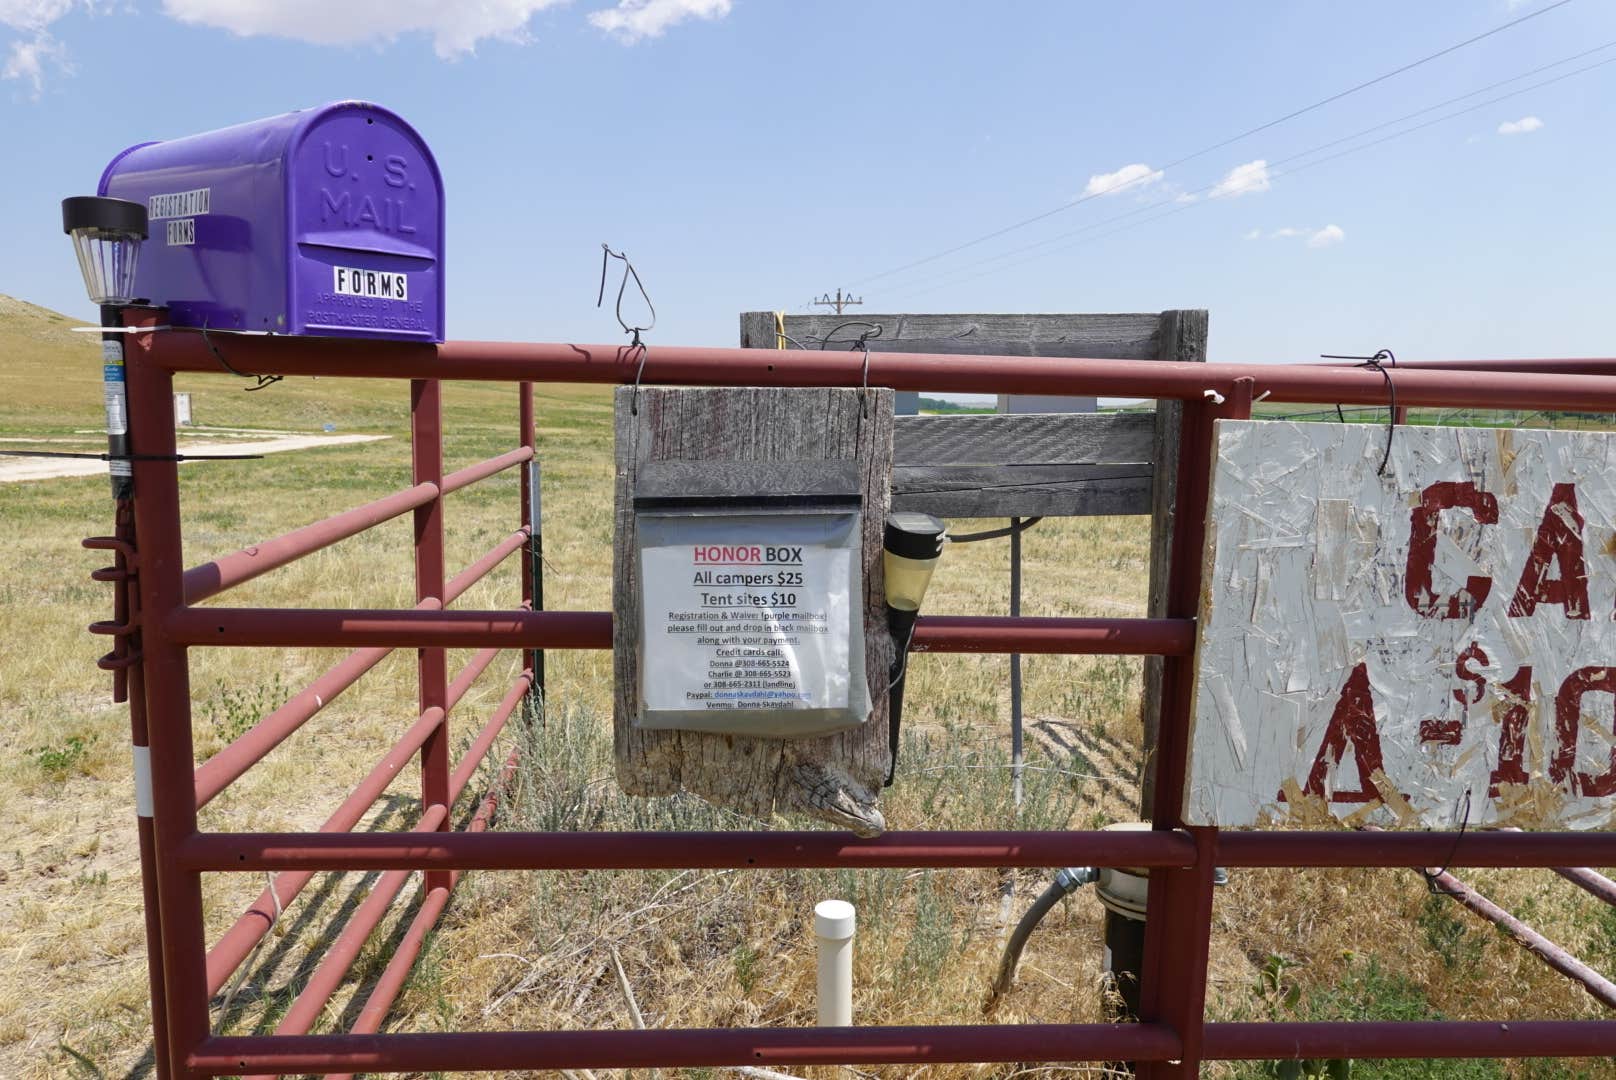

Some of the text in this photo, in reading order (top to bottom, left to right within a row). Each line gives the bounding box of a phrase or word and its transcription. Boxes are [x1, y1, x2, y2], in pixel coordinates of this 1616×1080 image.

[150, 189, 209, 218] REGISTRATION
[321, 187, 416, 233] MAIL
[168, 220, 194, 244] FORMS
[338, 269, 404, 298] FORMS
[694, 546, 802, 562] HONOR BOX
[694, 571, 803, 587] All campers $25
[701, 592, 796, 607] Tent sites $10
[668, 611, 719, 621] Registration
[721, 611, 728, 620] &
[730, 611, 758, 620] Waiver
[761, 611, 790, 621] (purple
[667, 624, 695, 633] please
[697, 623, 708, 632] fill
[726, 624, 741, 632] and
[743, 624, 762, 633] drop
[764, 624, 772, 632] in
[774, 624, 794, 632] black
[697, 636, 720, 645] along
[722, 636, 740, 644] with
[743, 637, 761, 645] your
[716, 648, 741, 656] Credit
[766, 649, 783, 657] call:
[708, 670, 733, 678] Charlie
[762, 680, 795, 689] (landline)
[686, 690, 811, 699] Paypal: donnaskavdahl@yahoo.
[737, 700, 760, 708] Donna
